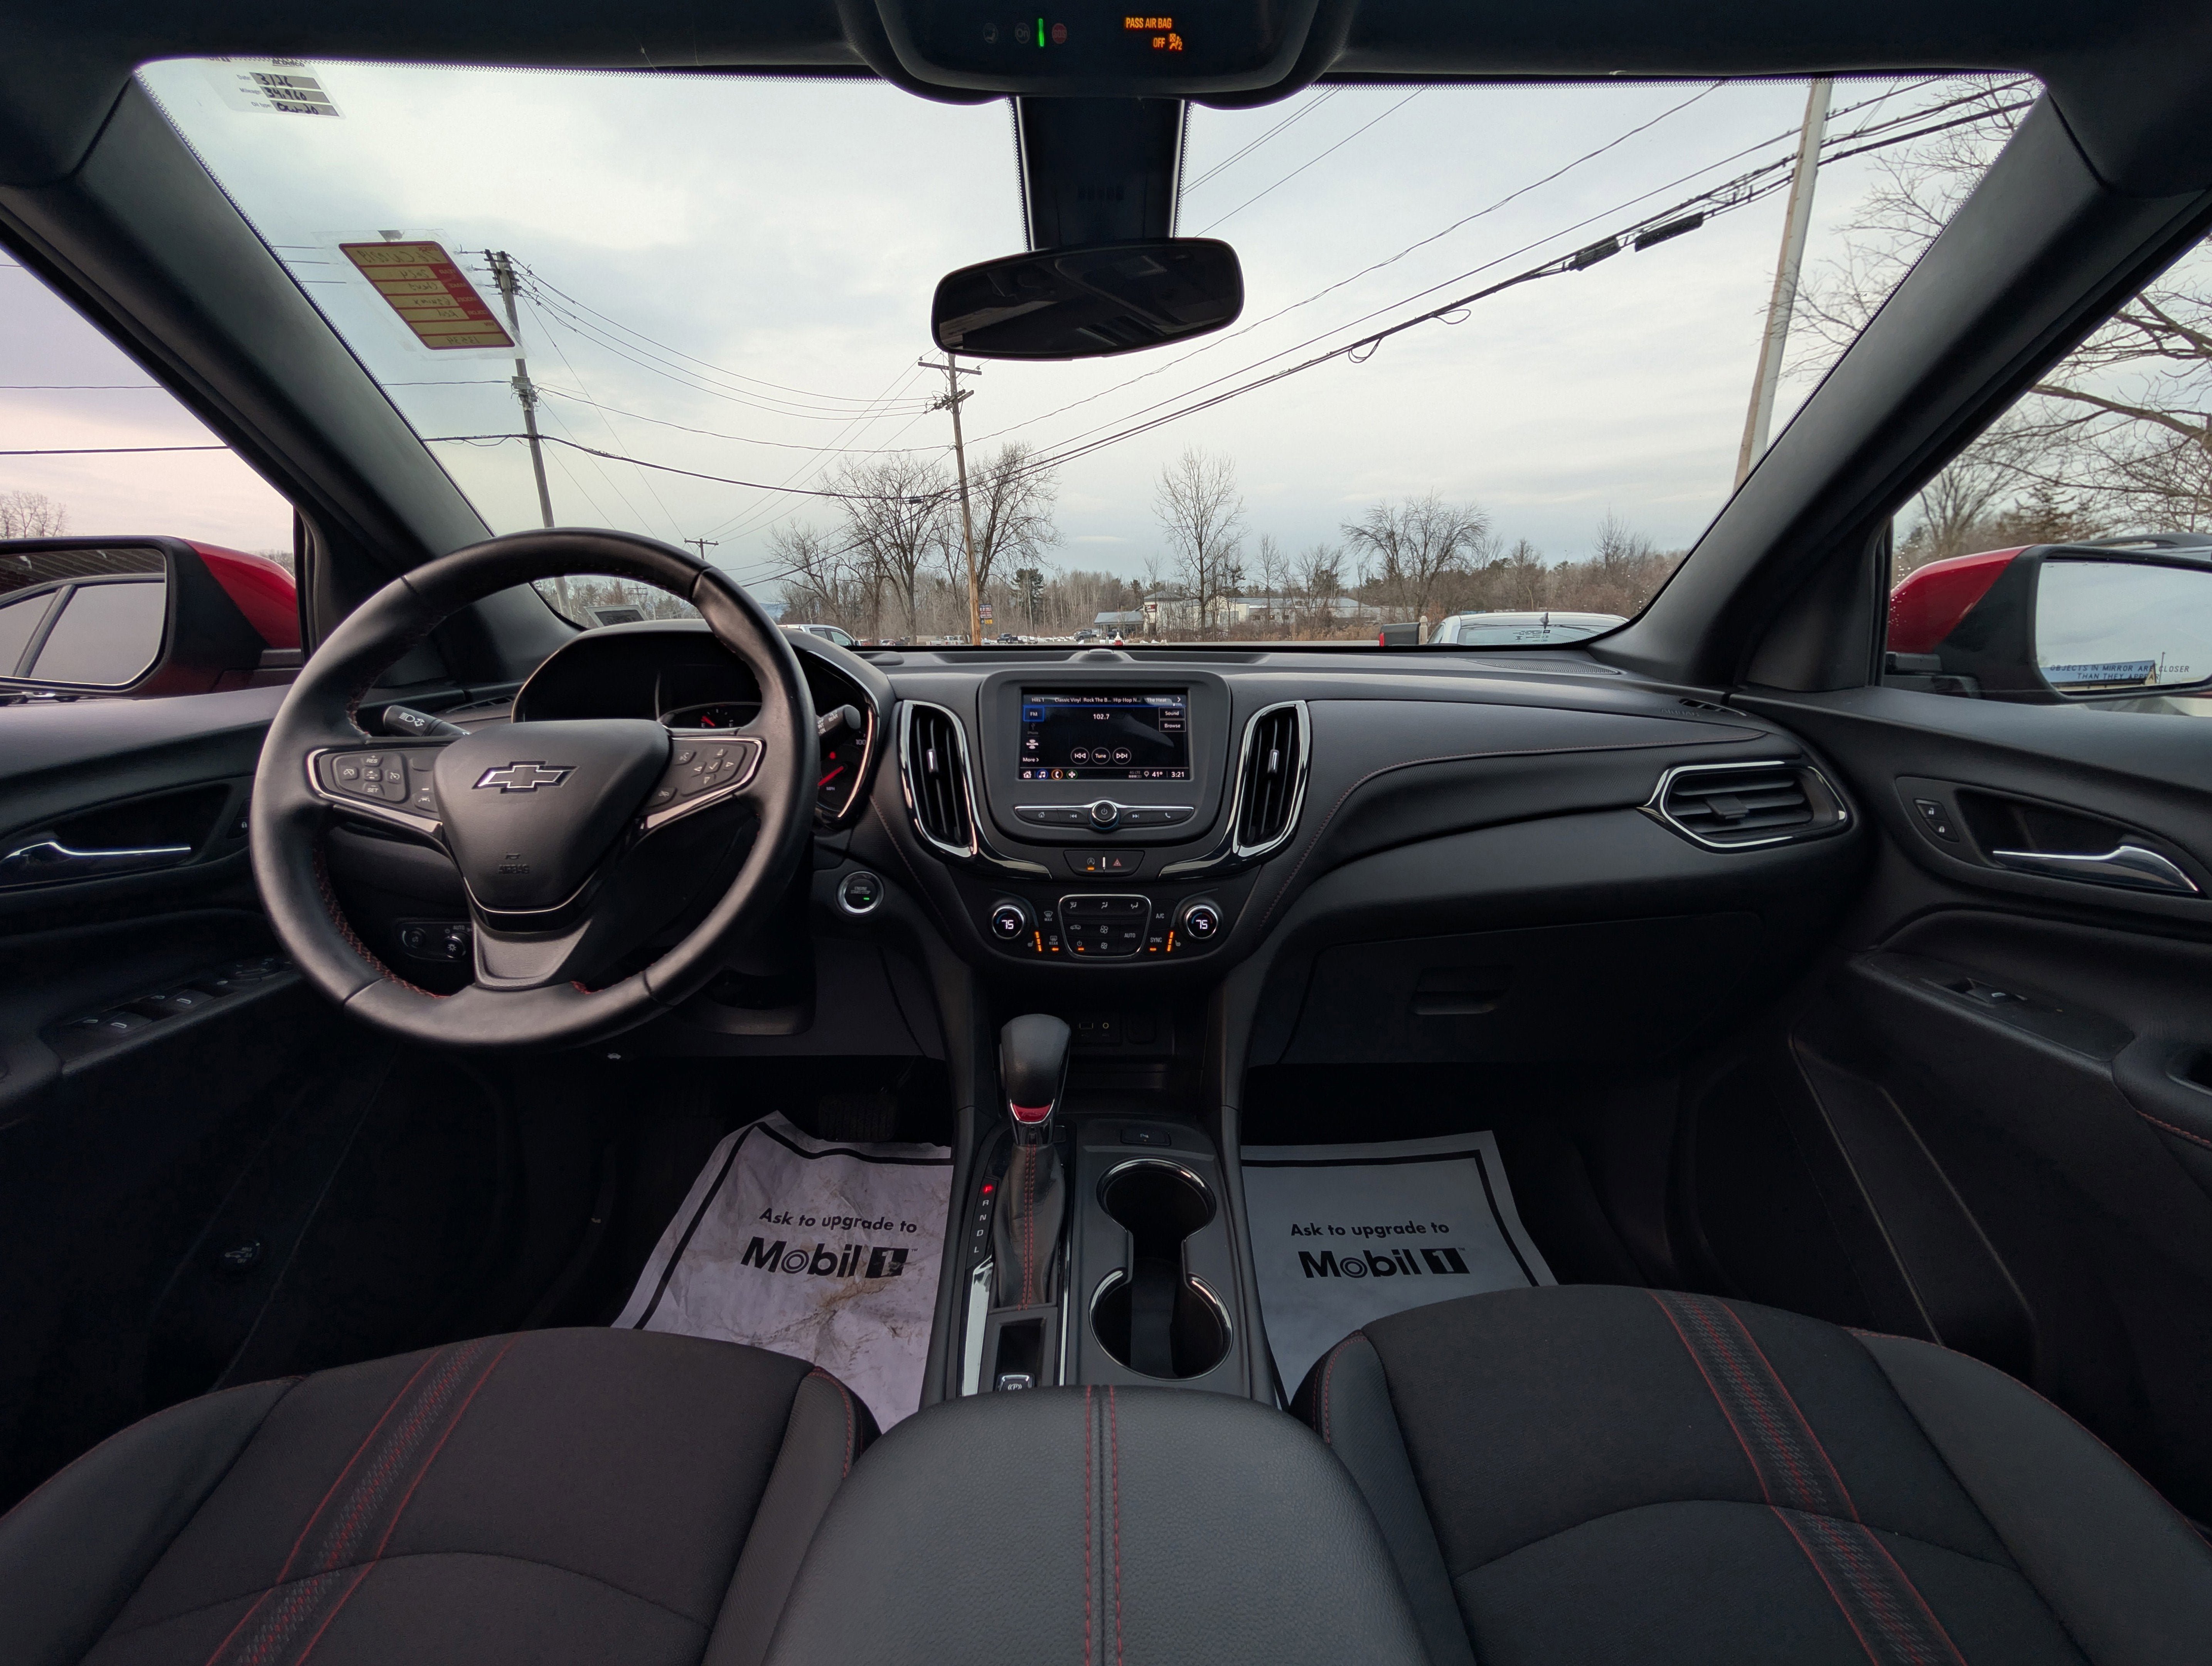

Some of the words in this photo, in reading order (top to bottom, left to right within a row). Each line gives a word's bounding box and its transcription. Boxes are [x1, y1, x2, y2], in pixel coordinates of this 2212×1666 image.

[1125, 17, 1144, 28] PASS
[1145, 18, 1156, 28] AIR
[1158, 18, 1172, 28] BAG
[1017, 29, 1029, 37] On
[1153, 37, 1165, 47] OFF
[1001, 920, 1014, 929] 75
[1196, 919, 1208, 929] 75
[759, 1208, 794, 1225] Ask
[799, 1214, 816, 1227] to
[822, 1216, 894, 1230] upgrade
[900, 1220, 917, 1233] to
[1291, 1223, 1324, 1236] Ask
[1328, 1225, 1346, 1235] to
[1351, 1221, 1427, 1239] upgrade
[1431, 1222, 1450, 1233] to
[740, 1236, 863, 1278] Mobil
[1298, 1249, 1422, 1278] Mobil
